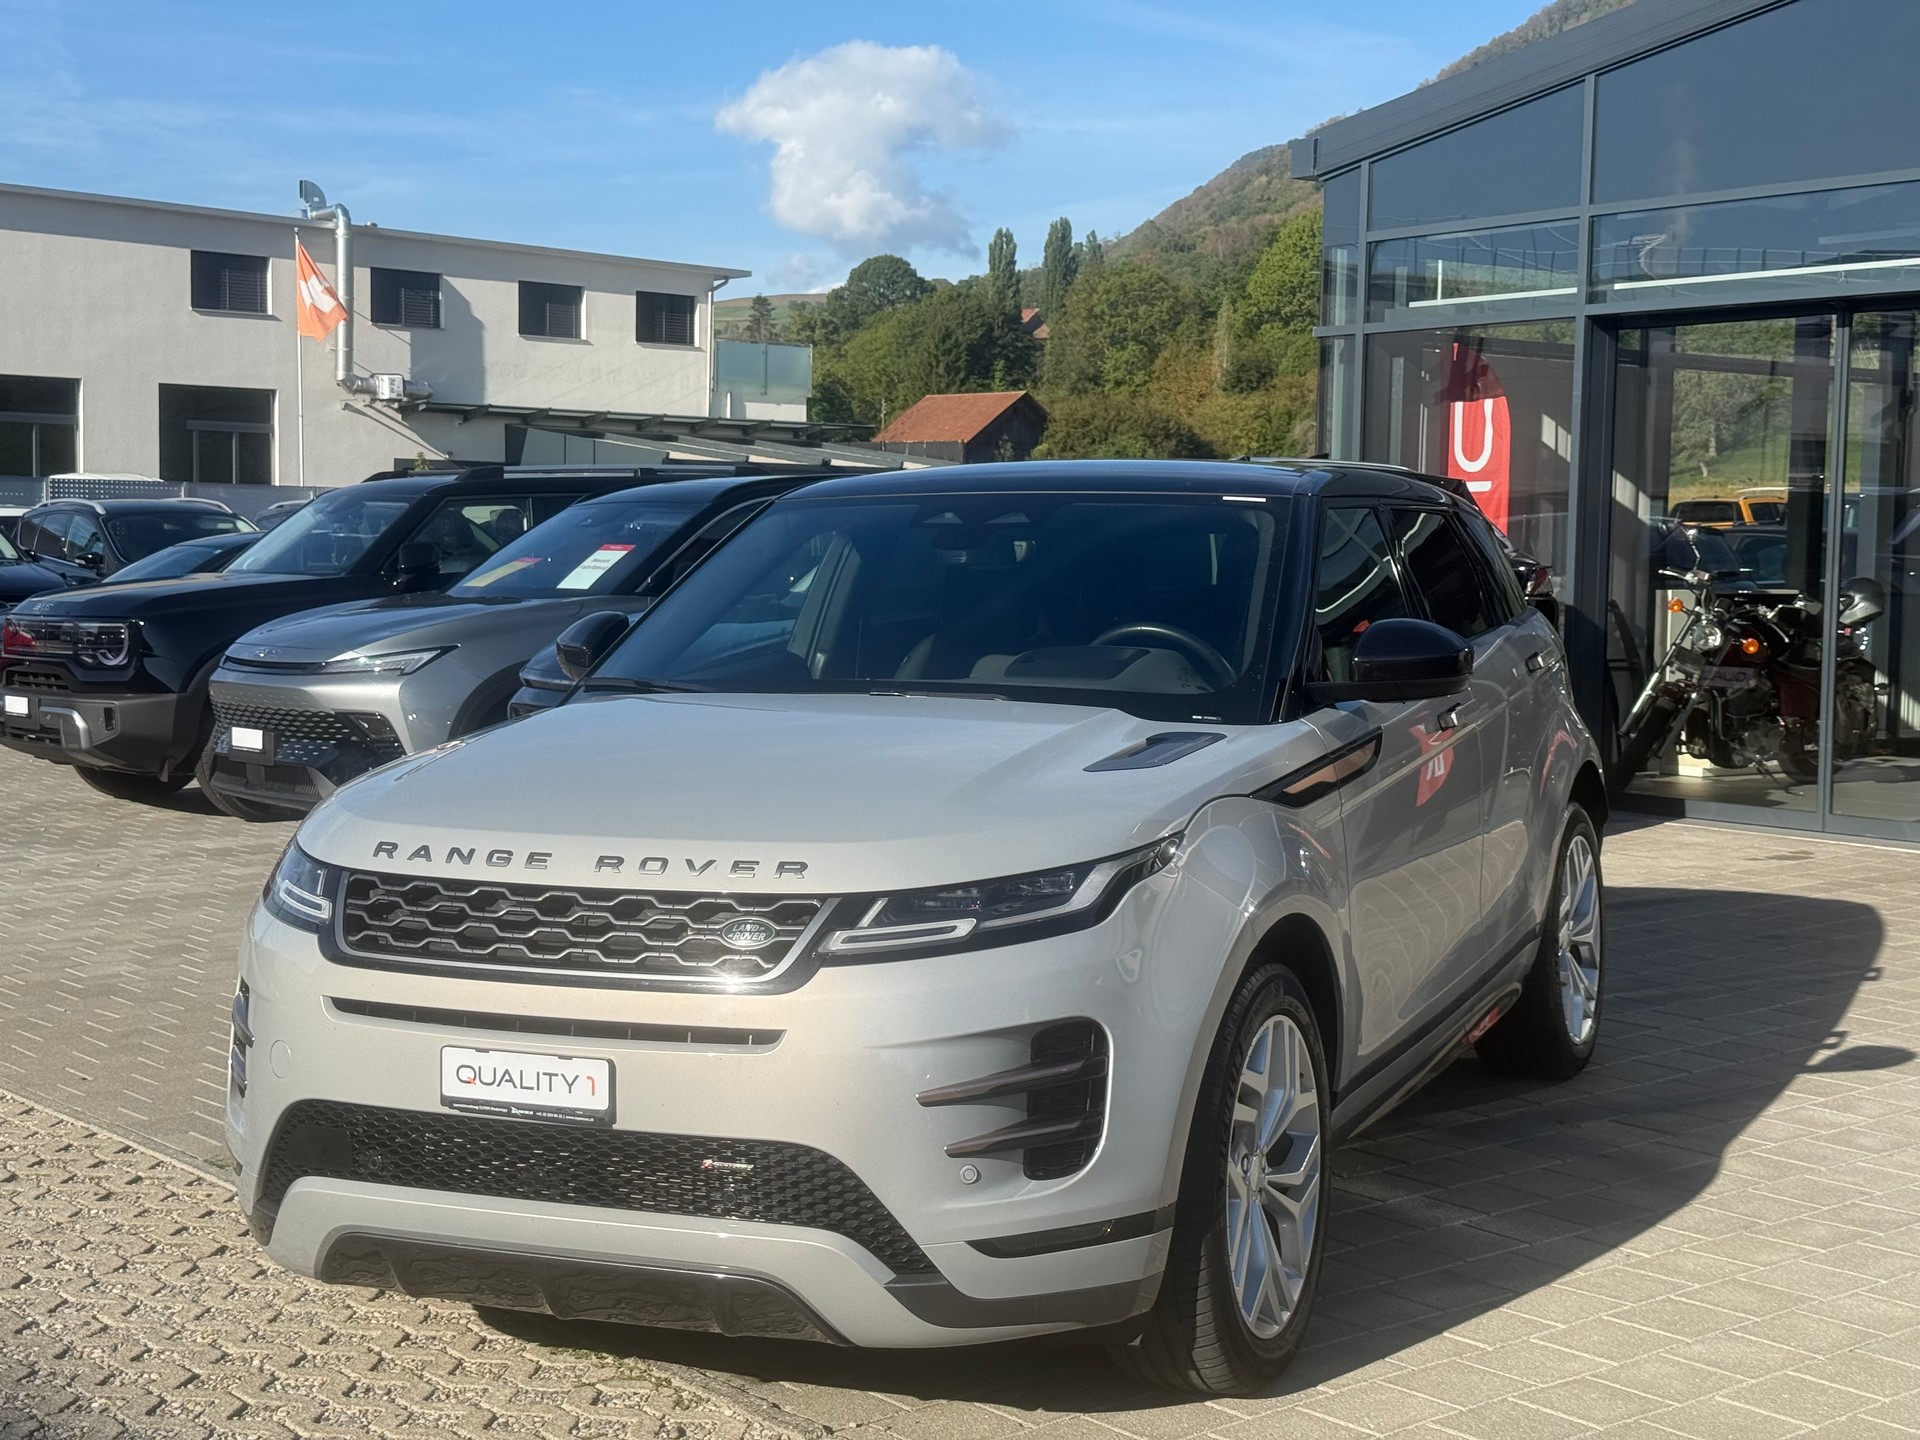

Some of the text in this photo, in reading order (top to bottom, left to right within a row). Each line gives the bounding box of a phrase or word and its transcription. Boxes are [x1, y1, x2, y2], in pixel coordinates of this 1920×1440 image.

[373, 840, 809, 880] RANGE ROVER
[731, 923, 760, 932] LAND
[732, 931, 766, 941] ROVER
[456, 1064, 596, 1097] QUALITY 1
